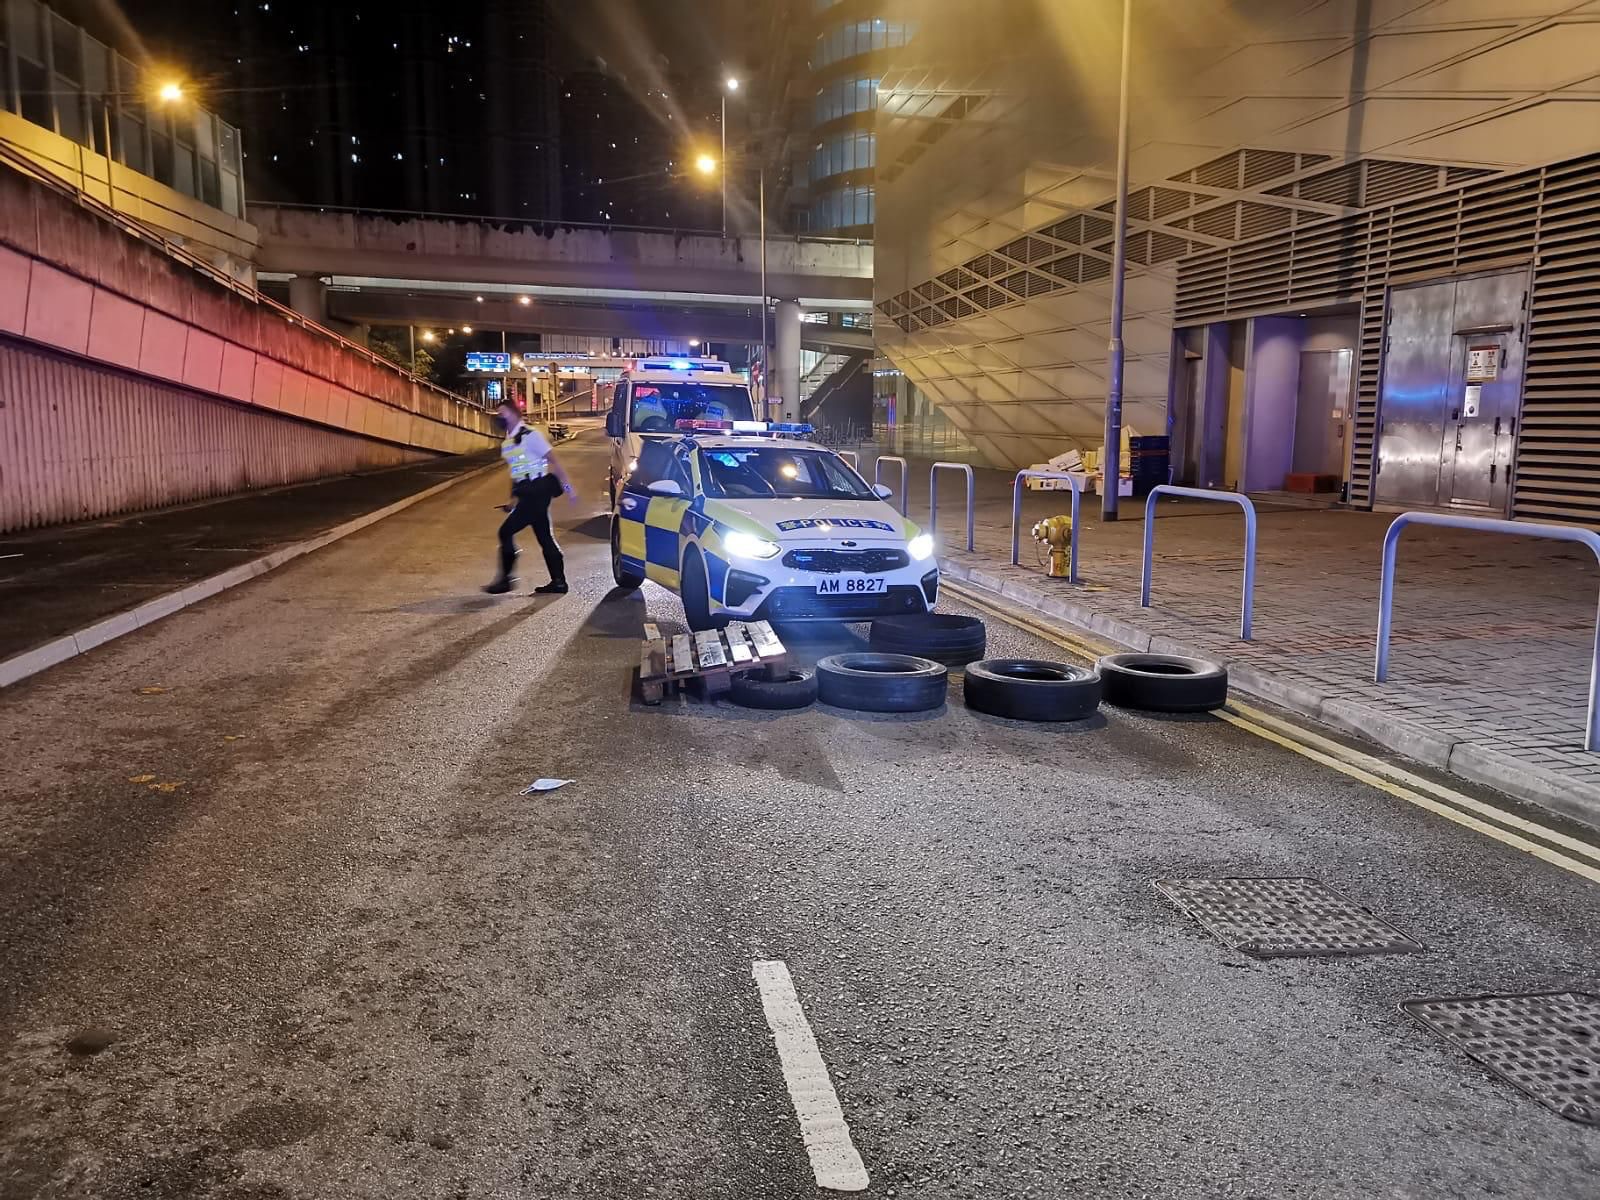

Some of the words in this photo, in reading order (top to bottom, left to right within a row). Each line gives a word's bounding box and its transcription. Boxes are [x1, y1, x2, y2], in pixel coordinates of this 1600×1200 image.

[800, 519, 872, 529] POLICE
[819, 579, 840, 593] AM
[846, 578, 885, 592] 8827
